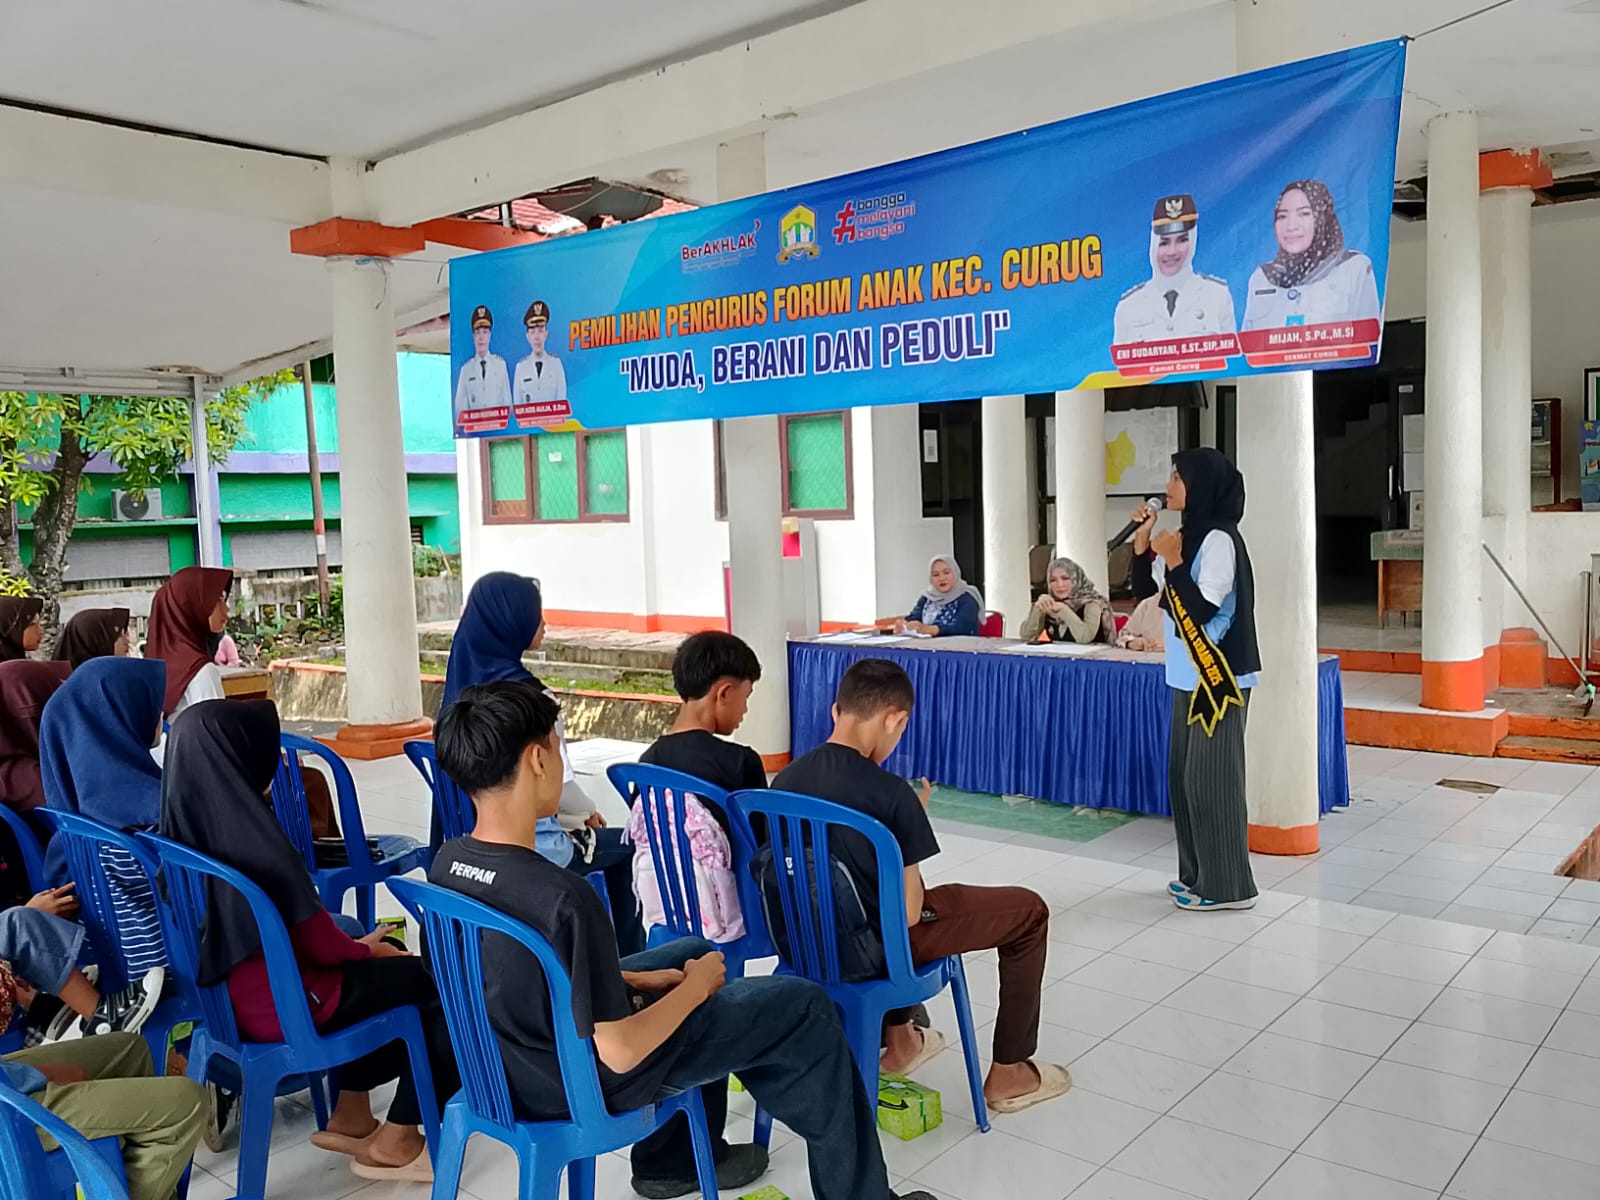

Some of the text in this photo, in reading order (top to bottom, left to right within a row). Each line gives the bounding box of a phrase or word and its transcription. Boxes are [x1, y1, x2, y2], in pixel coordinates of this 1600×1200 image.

[857, 204, 916, 226] melayani
[857, 222, 905, 241] bangsa
[682, 232, 756, 262] BerAKHLAK
[569, 234, 1104, 351] PEMILIHAN PENGURUS FORUM ANAK KEC. CURUG
[1268, 332, 1303, 345] MIJAH,
[620, 310, 1010, 394] "MUDA, BERANI DAN PEDULI"
[449, 860, 498, 886] PERPAM
